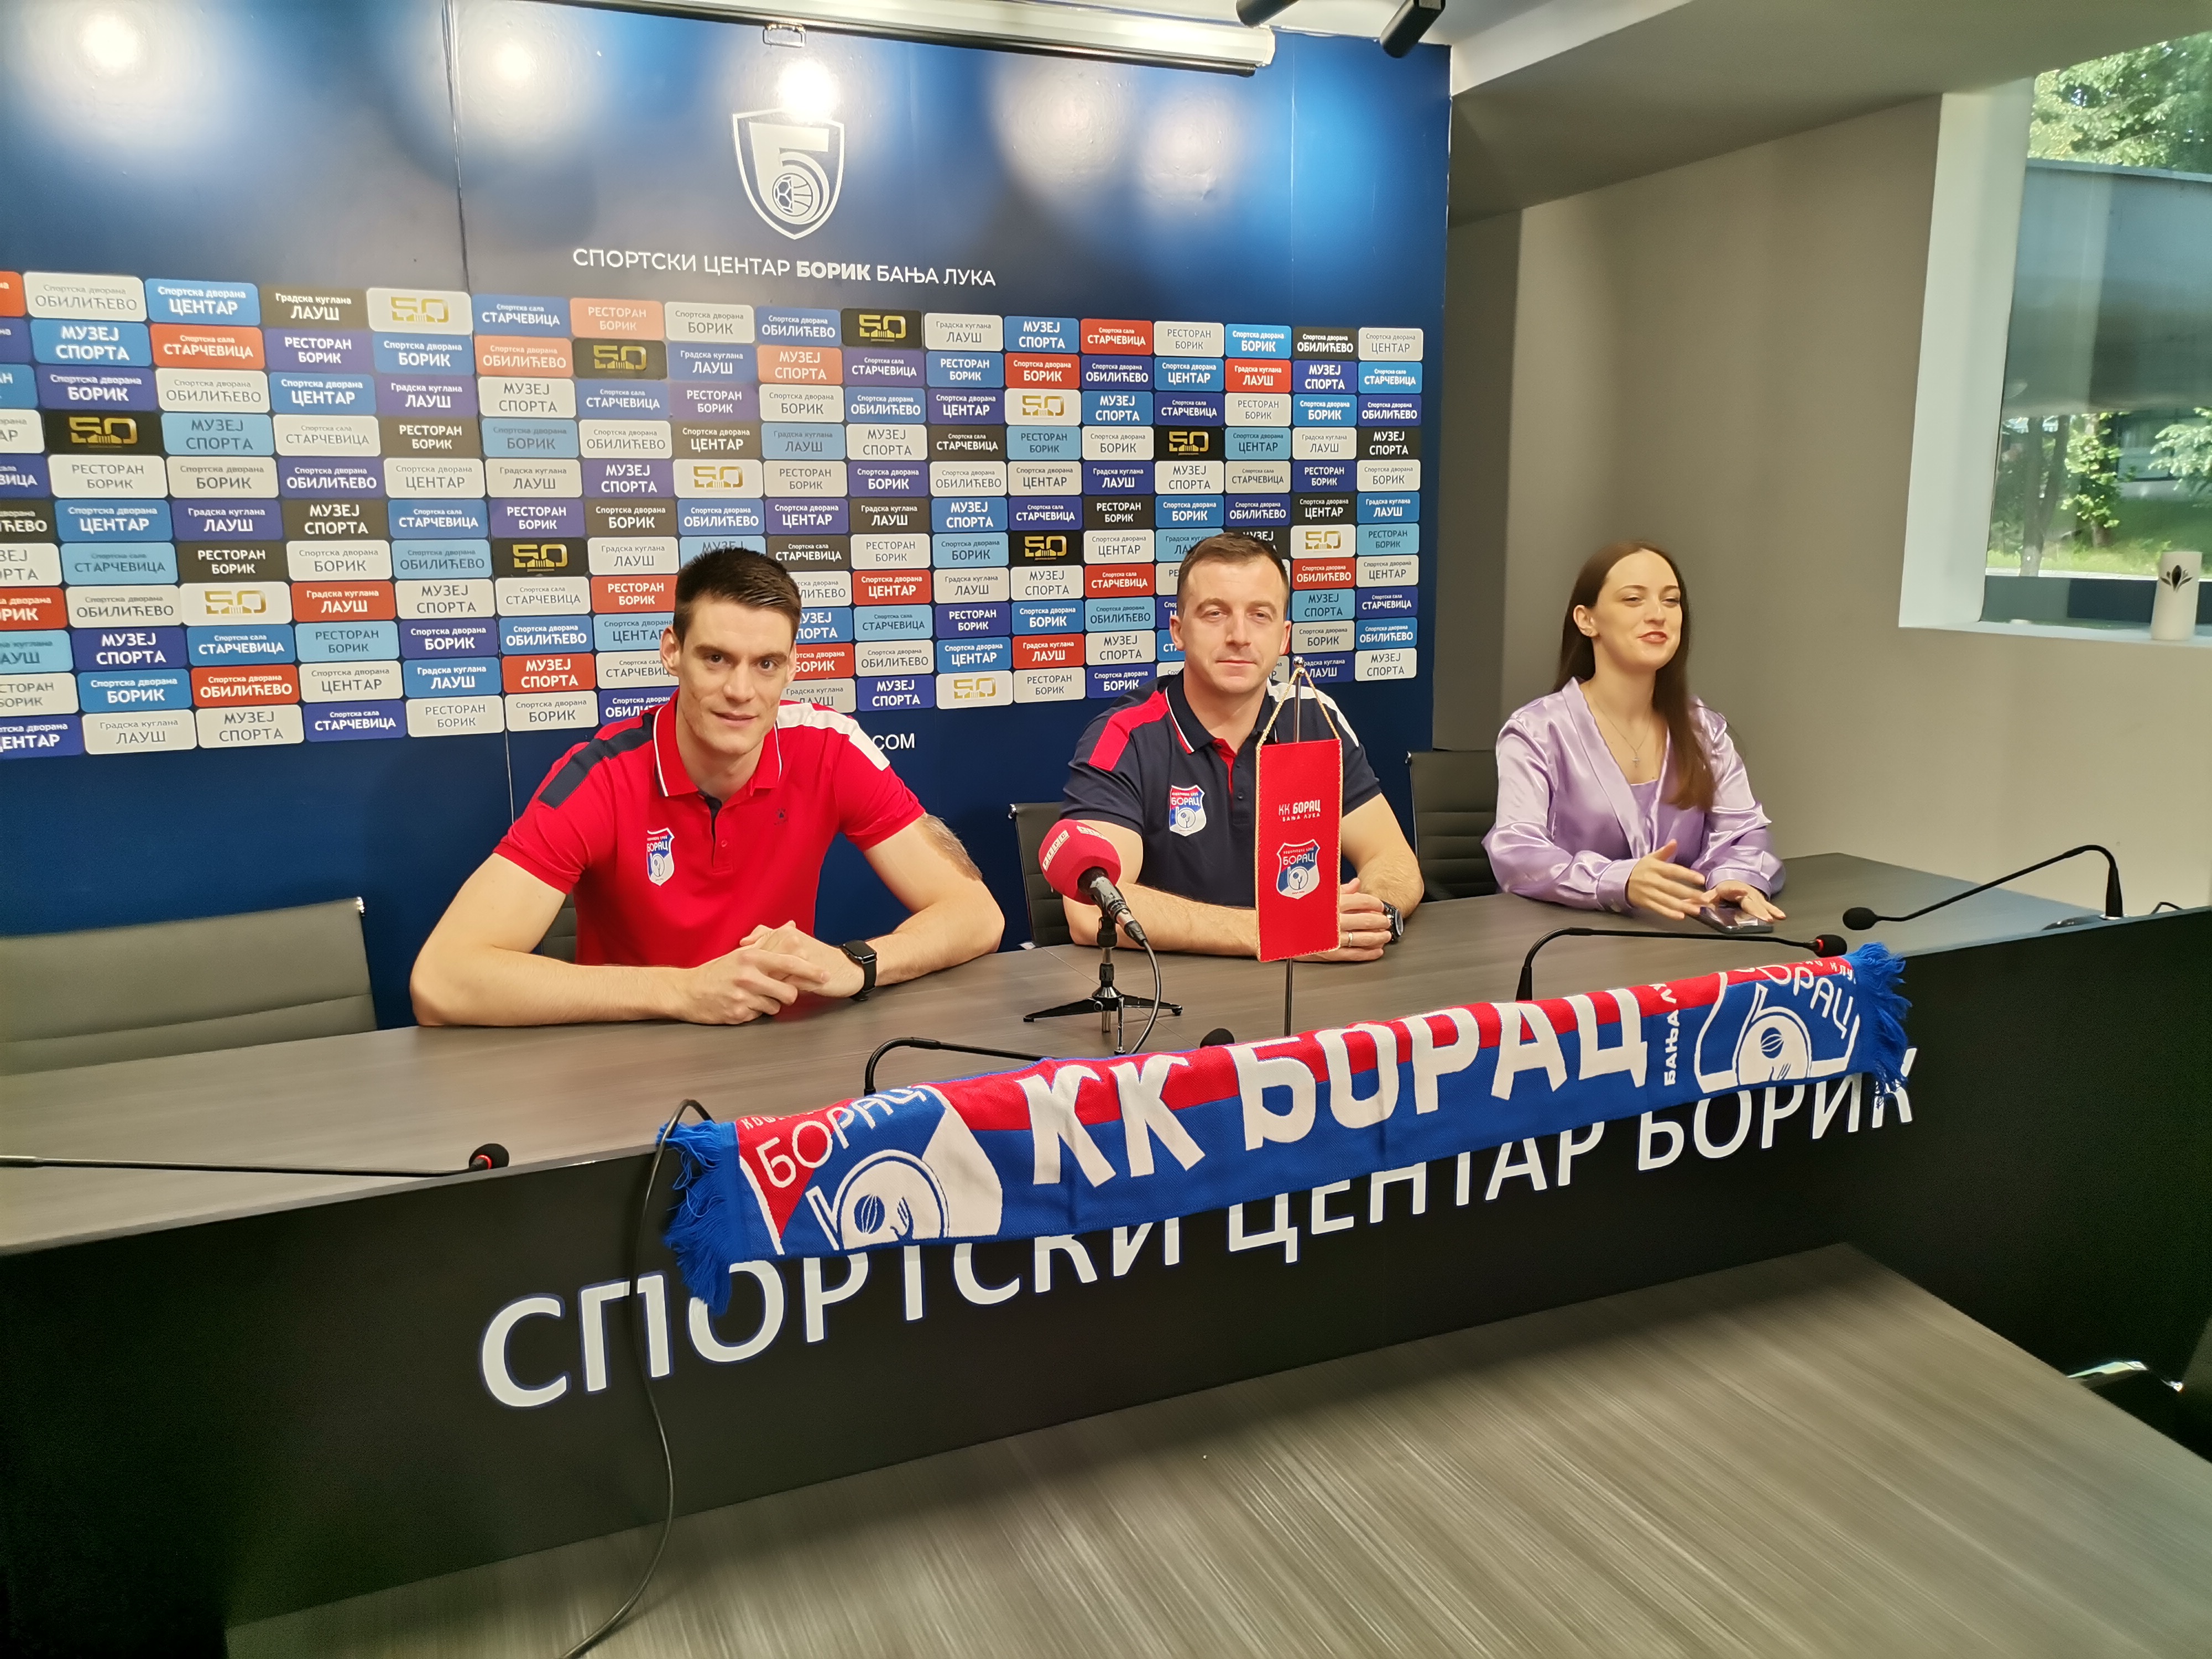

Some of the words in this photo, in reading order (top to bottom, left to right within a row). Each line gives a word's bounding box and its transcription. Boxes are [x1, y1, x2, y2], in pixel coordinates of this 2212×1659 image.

[573, 248, 696, 272] СПОРТСКИ
[704, 255, 791, 276] ЦЕНТАР
[797, 260, 871, 281] БОРИК
[878, 265, 939, 284] БАЊА
[943, 269, 996, 286] ЛУКА
[35, 295, 137, 311] ОБИЛИЋЕВО
[275, 293, 314, 304] Градска
[315, 296, 352, 305] куглана
[169, 298, 238, 316] ЦЕНТАР
[290, 305, 340, 321] ЛАУШ
[482, 311, 560, 327] СТАРЧЕВИЦА
[1023, 321, 1060, 333] МУЗЕЈ
[284, 336, 352, 350] РЕСТОРАН
[1019, 336, 1066, 349] СПОРТА
[1241, 340, 1276, 352] БОРИК
[1297, 342, 1354, 353] ОБИЛИЋЕВО
[298, 351, 342, 364] БОРИК
[680, 350, 712, 359] Градска
[692, 361, 733, 374] ЛАУШ
[1308, 364, 1341, 375] МУЗЕЈ
[1168, 372, 1211, 385] ЦЕНТАР
[1305, 378, 1345, 390] СПОРТА
[503, 382, 550, 395] МУЗЕЈ
[291, 390, 355, 407] ЦЕНТАР
[686, 389, 742, 401] РЕСТОРАН
[499, 400, 558, 413] СПОРТА
[697, 403, 733, 414] БОРИК
[851, 404, 921, 416] ОБИЛИЋЕВО
[1161, 406, 1217, 419] СТАРЧЕВИЦА
[1361, 409, 1417, 419] ОБИЛИЋЕВО
[191, 419, 243, 432] МУЗЕЈ
[399, 424, 462, 436] РЕСТОРАН
[1373, 431, 1405, 442] МУЗЕЈ
[185, 437, 254, 450] СПОРТА
[411, 439, 452, 450] БОРИК
[691, 438, 744, 453] ЦЕНТАР
[1369, 445, 1409, 456] СПОРТА
[606, 464, 650, 476] МУЗЕЈ
[1304, 466, 1345, 476] РЕСТОРАН
[286, 477, 377, 489] ОБИЛИЋЕВО
[601, 481, 658, 493] СПОРТА
[868, 478, 910, 490] БОРИК
[1311, 477, 1338, 486] БОРИК
[310, 504, 360, 517] МУЗЕЈ
[1096, 502, 1141, 512] РЕСТОРАН
[1104, 513, 1134, 523] БОРИК
[1229, 509, 1286, 520] ОБИЛИЋЕВО
[304, 521, 369, 535] СПОРТА
[399, 517, 479, 530] СТАРЧЕВИЦА
[608, 516, 655, 529] БОРИК
[1368, 530, 1408, 539] РЕСТОРАН
[1375, 540, 1401, 549] БОРИК
[197, 549, 266, 561] РЕСТОРАН
[775, 551, 842, 562] СТАРЧЕВИЦА
[211, 563, 256, 575] БОРИК
[1296, 571, 1352, 582] ОБИЛИЋЕВО
[608, 582, 664, 593] РЕСТОРАН
[868, 585, 916, 599] ЦЕНТАР
[306, 590, 343, 599] Градска
[344, 590, 379, 599] куглана
[618, 595, 655, 606] БОРИК
[321, 599, 368, 613] ЛАУШ
[1029, 615, 1067, 628] БОРИК
[101, 632, 156, 647] МУЗЕЈ
[506, 633, 587, 646] ОБИЛИЋЕВО
[1103, 635, 1138, 646] МУЗЕЈ
[1366, 631, 1413, 643] ОБИЛИЋЕВО
[424, 637, 476, 650] БОРИК
[96, 650, 167, 665] СПОРТА
[1099, 649, 1142, 661] СПОРТА
[1370, 653, 1401, 664] МУЗЕЈ
[417, 667, 452, 676] Градска
[453, 666, 487, 675] куглана
[1366, 666, 1405, 677] СПОРТА
[430, 675, 476, 690] ЛАУШ
[877, 679, 915, 692] МУЗЕЈ
[200, 683, 293, 698] ОБИЛИЋЕВО
[872, 693, 921, 707] СПОРТА
[224, 711, 274, 725] МУЗЕЈ
[219, 728, 284, 742] СПОРТА
[1171, 797, 1200, 807] БОРАЦ
[1278, 803, 1291, 816] КК
[1292, 799, 1321, 815] БОРАЦ
[646, 841, 668, 852] БОРАЦ
[1283, 852, 1315, 865] БОРАЦ
[1829, 961, 1857, 985] КЛУ
[1734, 964, 1854, 1040] ОРАЦ
[1664, 1009, 1681, 1087] БАЊА
[1014, 1054, 1206, 1188] КК
[1224, 988, 1648, 1151] БОРАЦ
